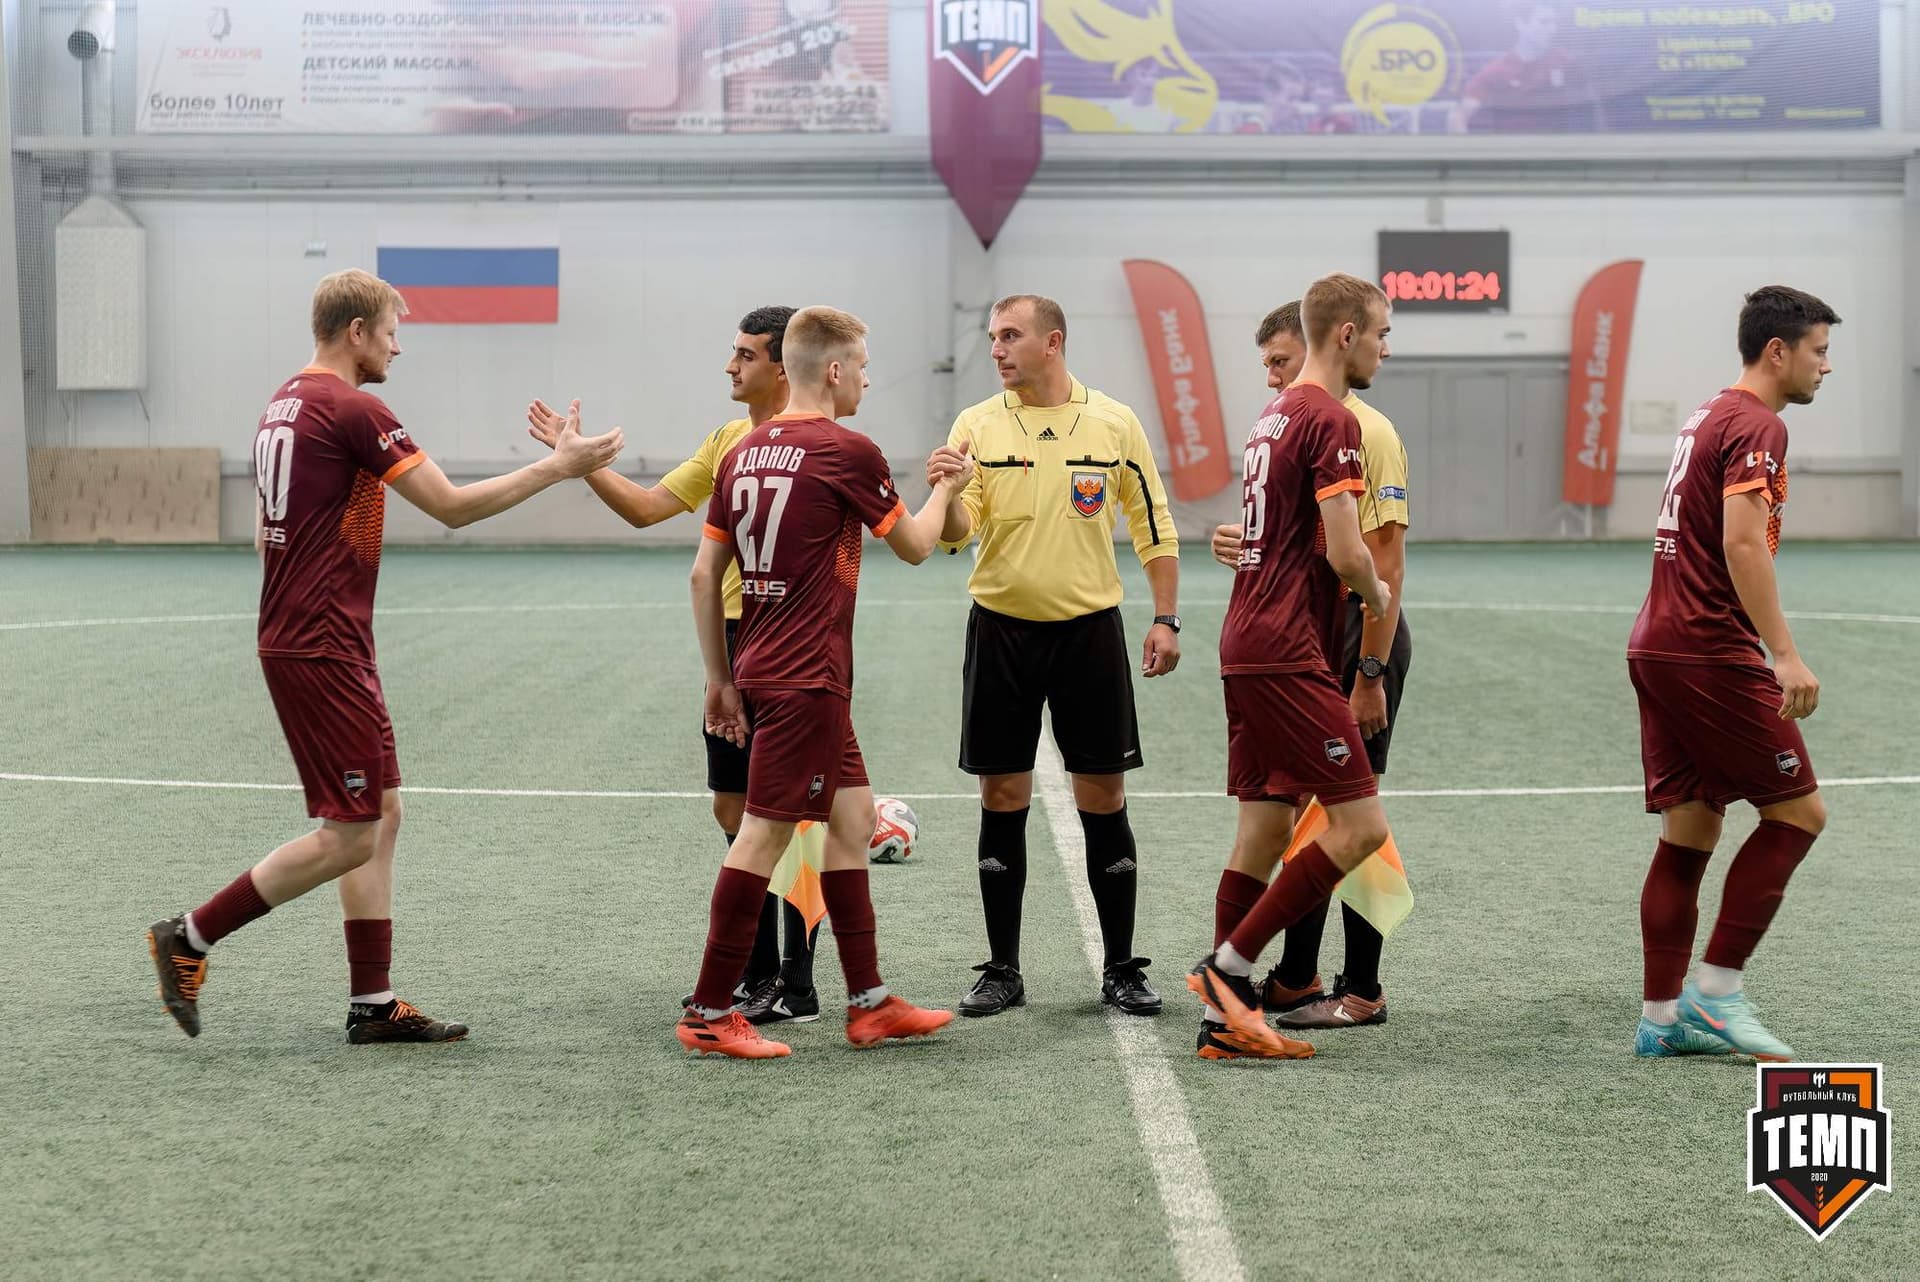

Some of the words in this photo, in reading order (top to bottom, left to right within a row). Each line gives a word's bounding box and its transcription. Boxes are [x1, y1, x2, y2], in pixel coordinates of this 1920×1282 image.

[943, 1, 1027, 43] ТЕМП
[302, 56, 387, 71] ДЕТСКИЙ
[1370, 49, 1436, 71] .БРО
[150, 91, 216, 110] более
[224, 94, 285, 110] 10лет
[732, 476, 794, 572] 27
